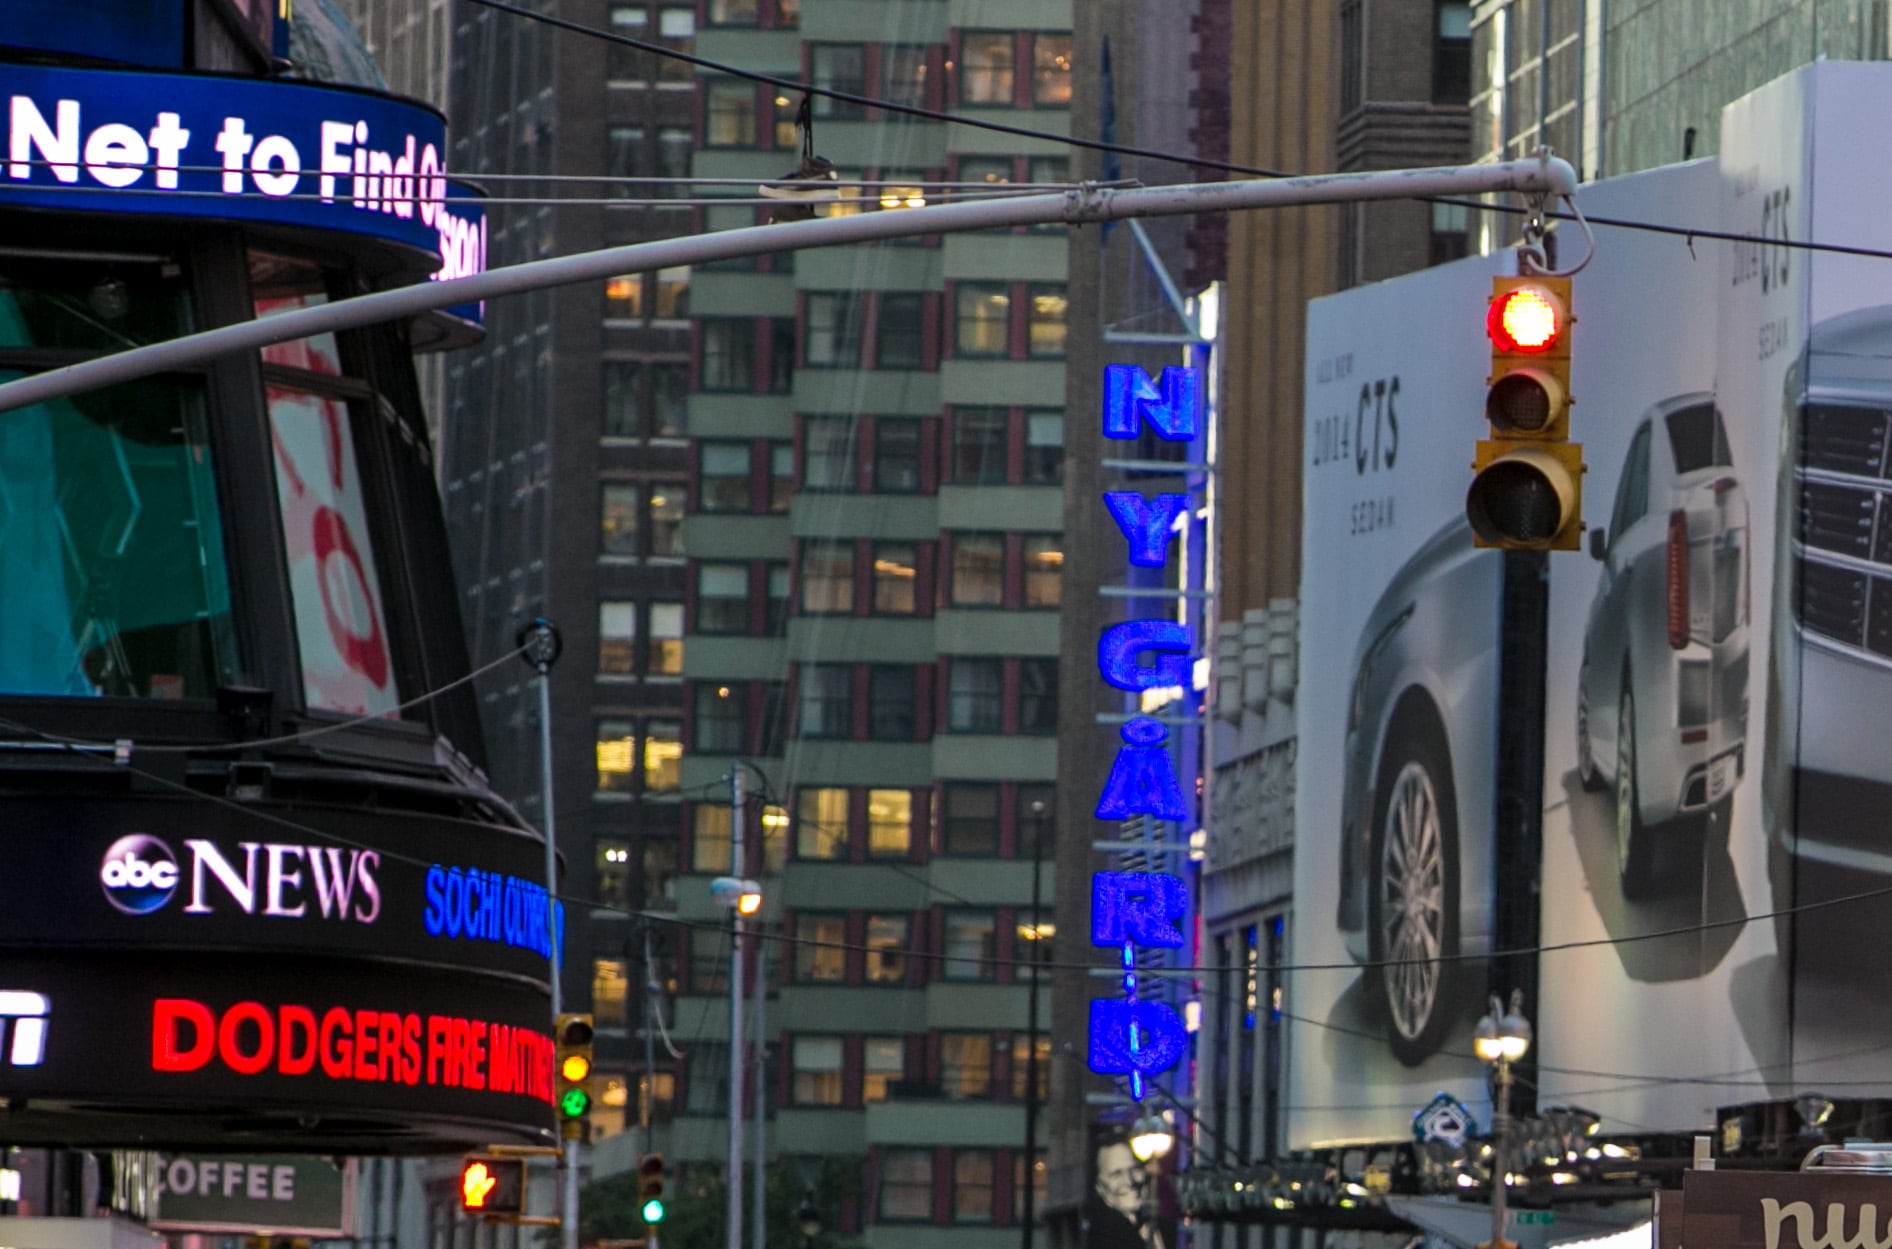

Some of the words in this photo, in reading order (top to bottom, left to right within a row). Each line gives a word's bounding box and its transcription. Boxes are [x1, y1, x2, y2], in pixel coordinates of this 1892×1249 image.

[9, 96, 189, 189] Net
[215, 117, 299, 196] to
[320, 119, 416, 219] Find
[1760, 183, 1791, 296] CTS
[1355, 374, 1399, 475] CTS
[1350, 496, 1396, 536] SEDAN
[102, 852, 179, 889] abc
[183, 839, 381, 923] NEWS
[424, 864, 501, 941] SOCHI
[153, 999, 422, 1086] DODGERS
[427, 1015, 488, 1090] FIRE
